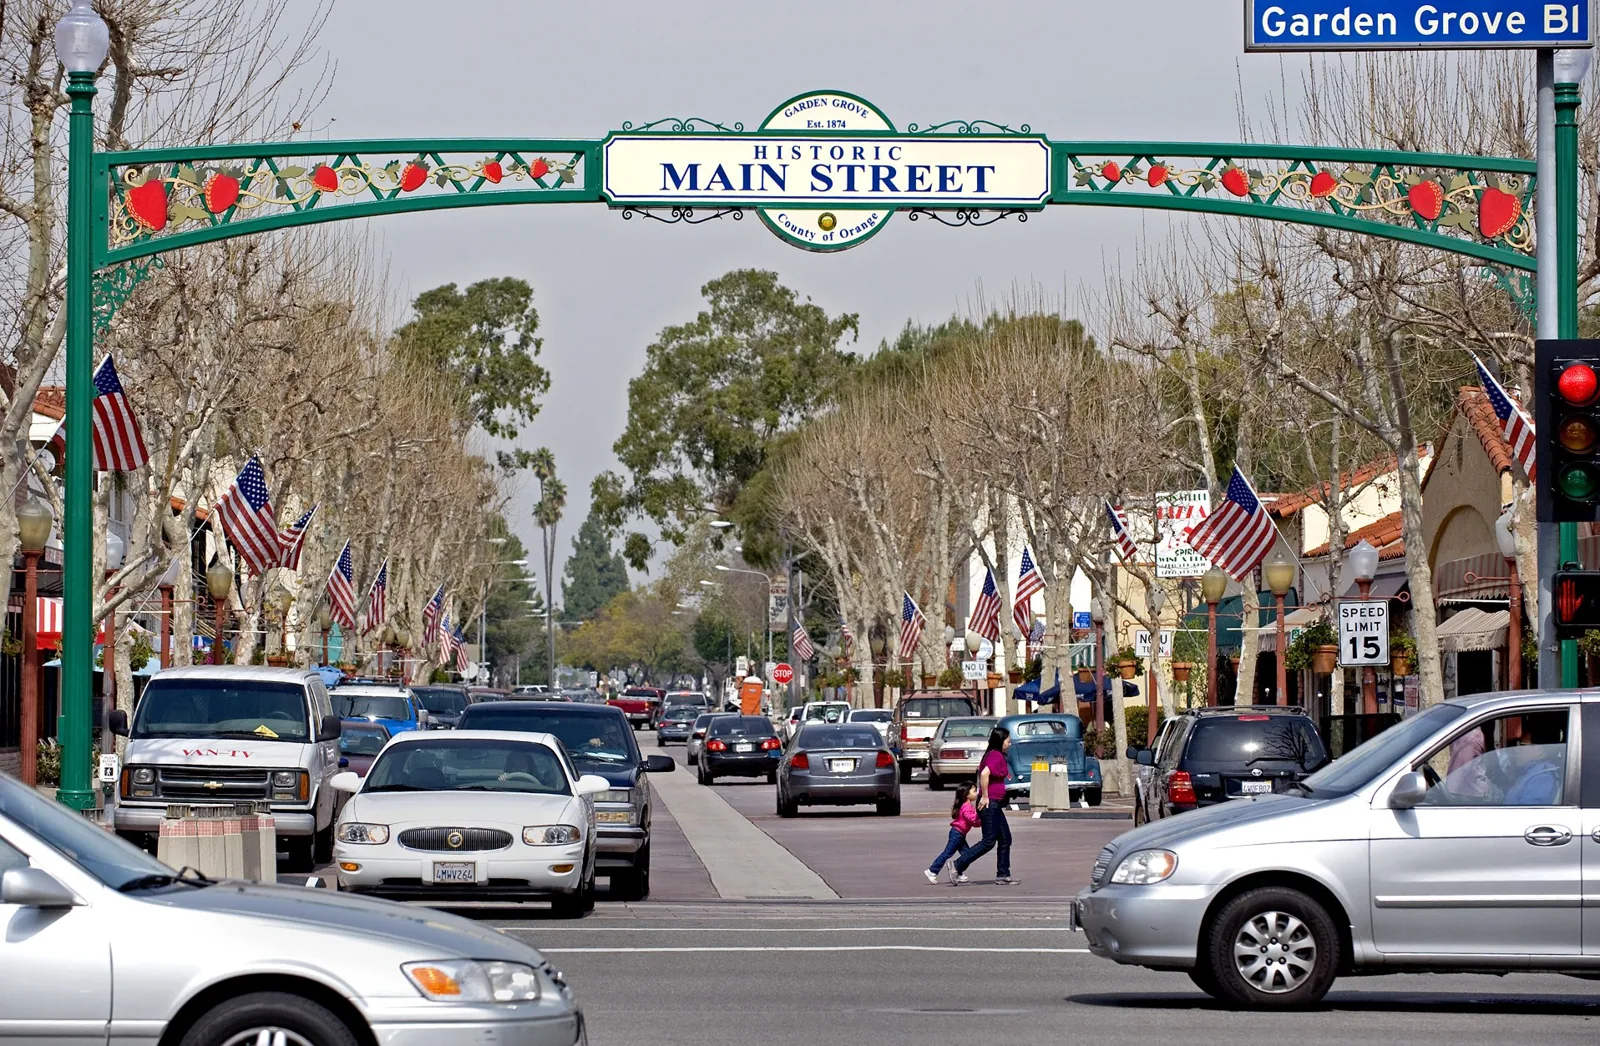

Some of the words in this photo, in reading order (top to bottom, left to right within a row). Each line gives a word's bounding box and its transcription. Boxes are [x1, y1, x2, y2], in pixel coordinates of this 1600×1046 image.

[1261, 5, 1397, 37] Garden
[1414, 4, 1526, 36] Grove
[1543, 4, 1579, 34] Bl
[784, 98, 828, 118] GARDEN
[832, 98, 869, 119] GROVE
[807, 120, 824, 128] Est.
[827, 120, 846, 128] 1874
[754, 145, 903, 161] HISTORIC
[659, 163, 789, 192] MAIN
[810, 163, 995, 193] STREET
[778, 213, 816, 241] County
[822, 232, 834, 241] of
[840, 212, 878, 239] Orange
[1342, 608, 1385, 618] SPEED
[1346, 621, 1381, 632] LIMIT
[1160, 634, 1168, 645] U
[1349, 636, 1381, 659] 15
[774, 669, 793, 678] STOP
[182, 749, 254, 758] VAN-TV
[436, 869, 473, 879] 4MWV264
